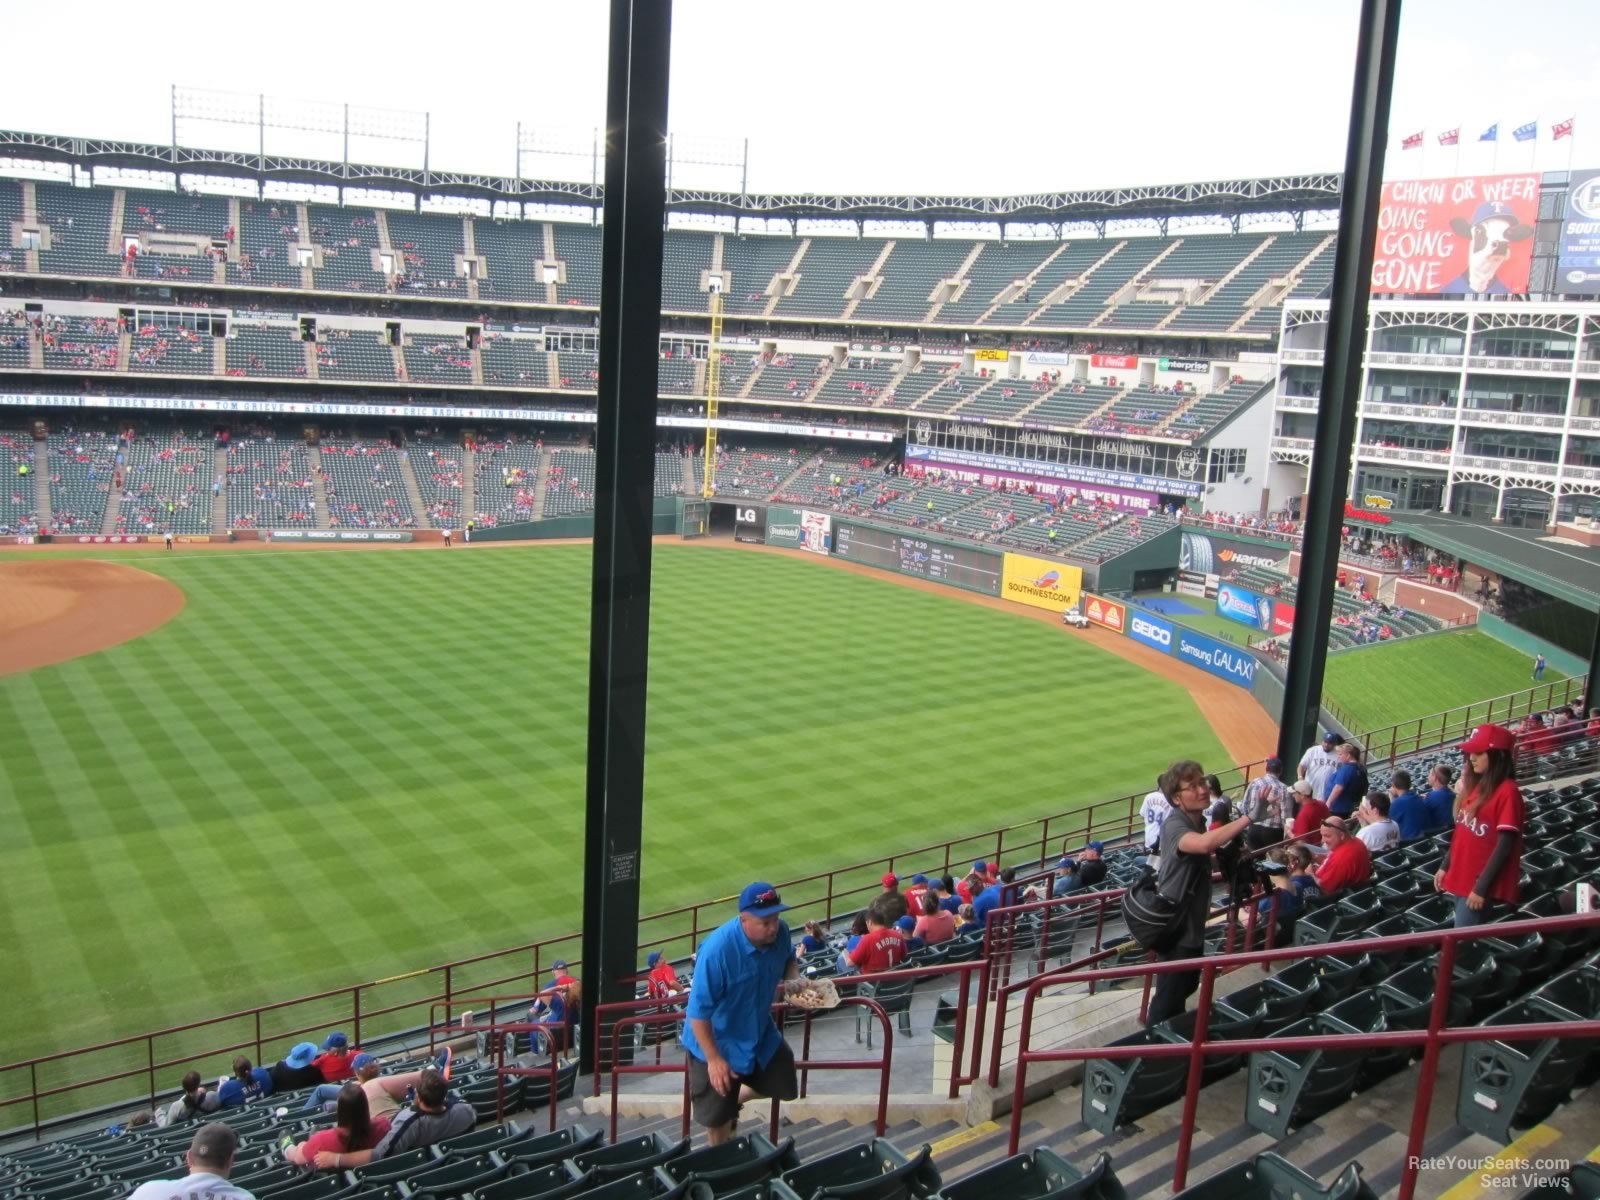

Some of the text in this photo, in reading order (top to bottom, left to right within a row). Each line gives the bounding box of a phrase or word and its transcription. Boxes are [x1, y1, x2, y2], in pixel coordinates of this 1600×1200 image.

[1392, 182, 1447, 204] CHIKIN
[1452, 179, 1476, 204] OR
[1482, 178, 1537, 201] WEER
[1378, 206, 1428, 232] OING
[1382, 231, 1454, 258] GOING
[1371, 259, 1442, 292] GONE
[1160, 360, 1208, 371] enterprise
[109, 398, 146, 407] RUBEN
[152, 400, 195, 409] SIERRA
[244, 402, 284, 412] GRIEVE
[346, 405, 387, 414] ROGERS
[403, 407, 427, 415] ERIC
[432, 408, 464, 416] NADEL
[480, 409, 504, 418] IVAN
[508, 410, 565, 419] RODRIGUEZ
[948, 423, 966, 435] JACK
[1018, 431, 1038, 444] JACK
[1096, 440, 1118, 453] JACK
[958, 471, 980, 482] TIRE
[1087, 470, 1106, 478] BOTTLE
[1168, 481, 1187, 489] TODAY
[1035, 482, 1060, 494] TIRE
[1080, 488, 1120, 504] NEXEN
[1122, 495, 1151, 509] TIRE
[736, 508, 756, 522] LG
[1230, 552, 1279, 568] Hanko
[1008, 582, 1071, 603] SOUTHWEST.COM
[1231, 597, 1256, 614] TOTAL
[1132, 617, 1171, 645] GEICO
[1180, 639, 1212, 665] Samsung
[1148, 809, 1163, 825] 84
[1457, 808, 1488, 836] XAS
[875, 936, 900, 950] ANDRUS
[888, 949, 892, 968] 1
